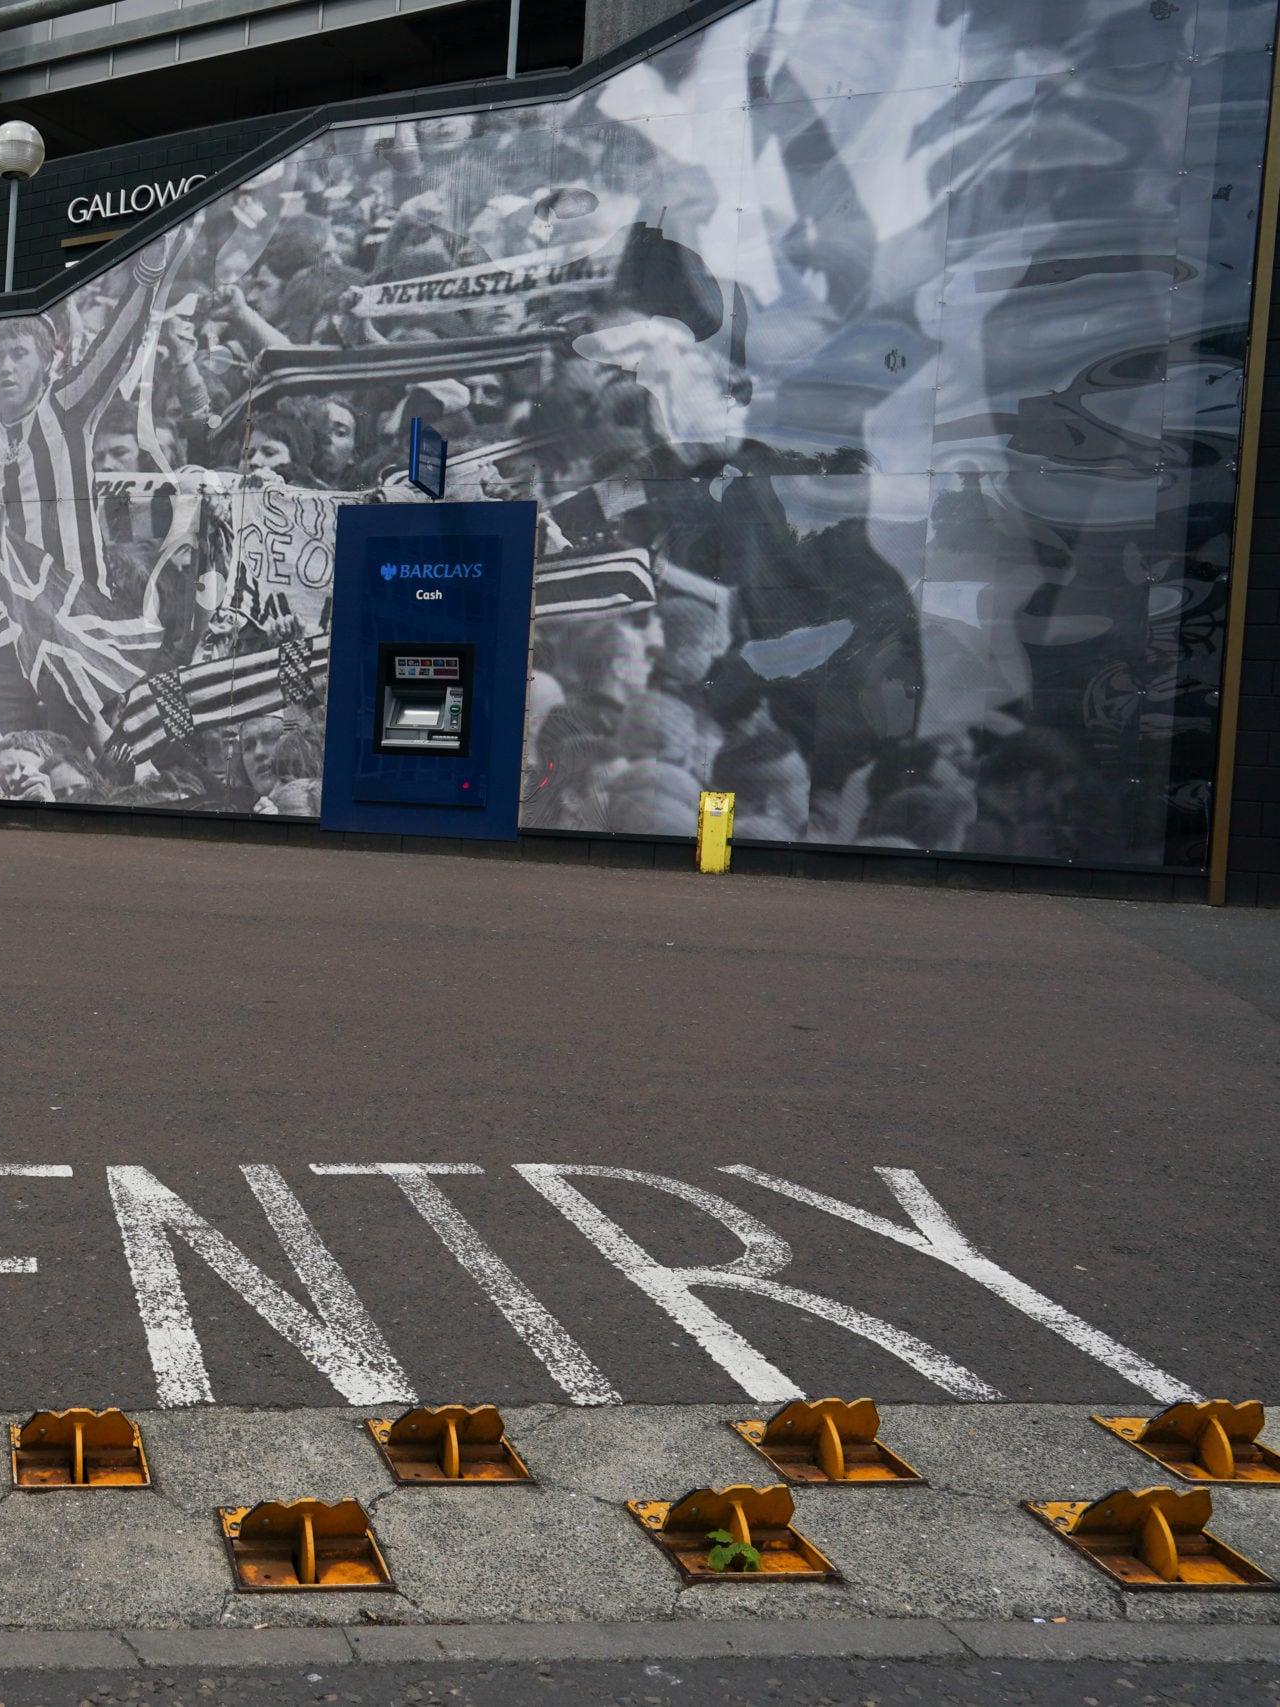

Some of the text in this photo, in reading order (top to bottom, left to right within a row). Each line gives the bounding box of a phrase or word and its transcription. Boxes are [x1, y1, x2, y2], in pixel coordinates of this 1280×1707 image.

[376, 265, 537, 305] NEWCASTLE
[400, 563, 482, 578] BARCLAYS
[415, 589, 443, 600] Cash
